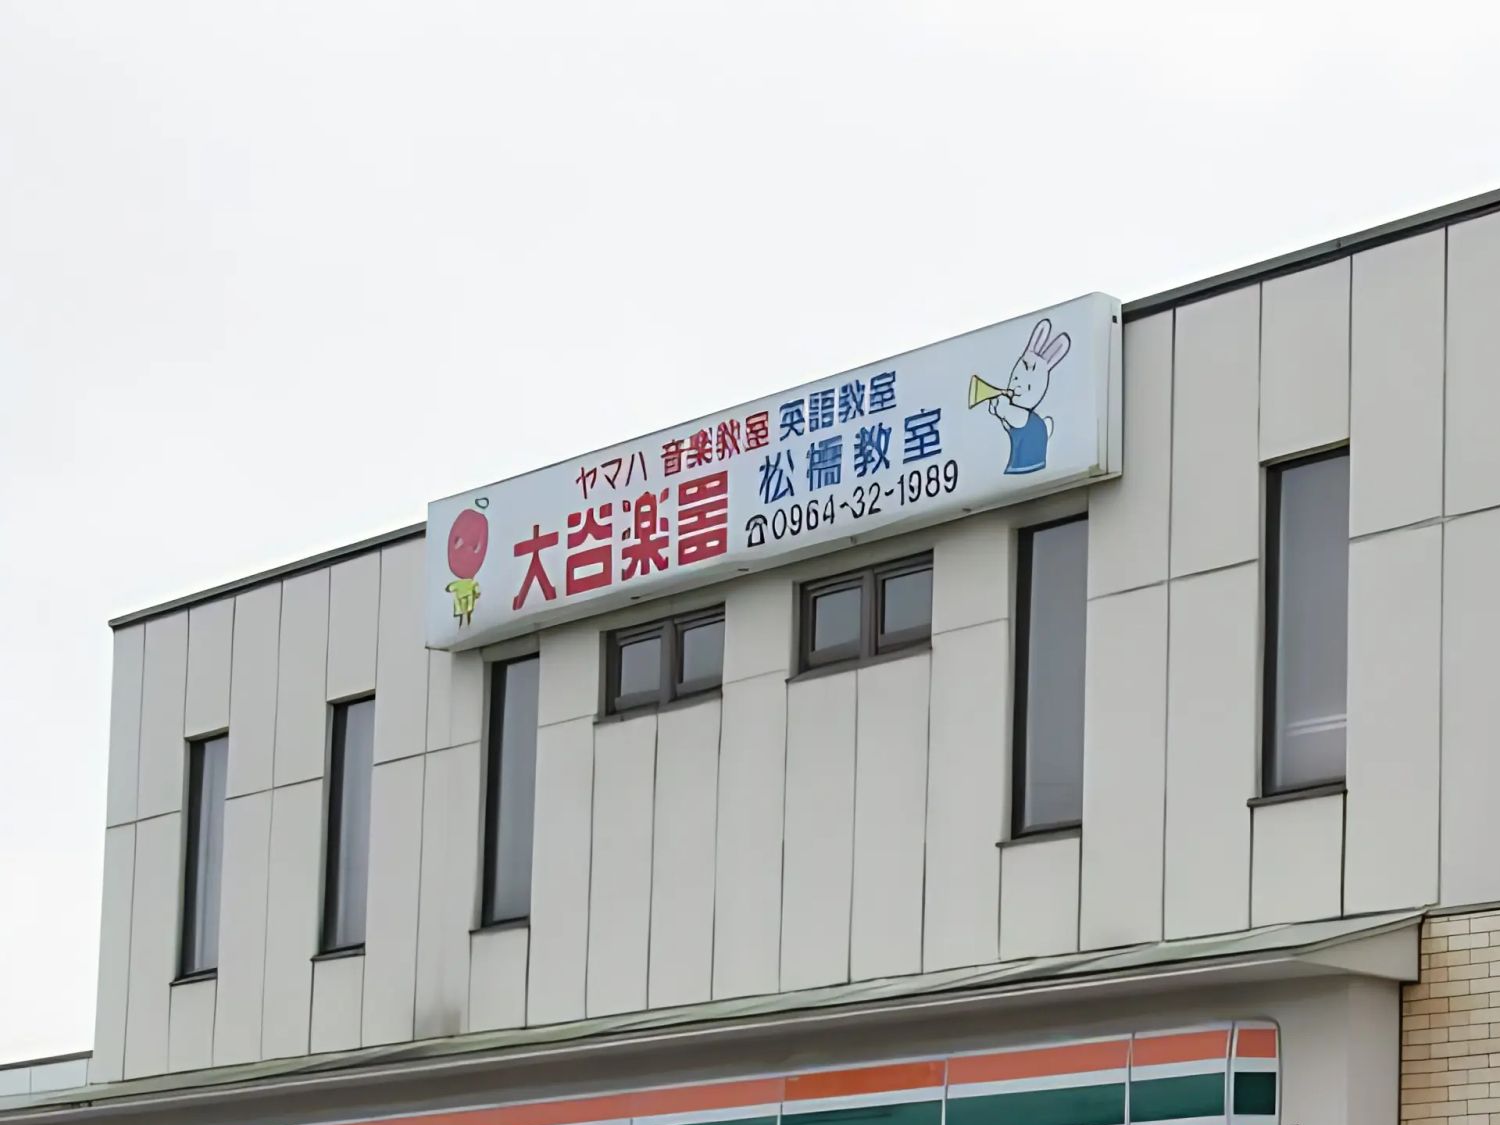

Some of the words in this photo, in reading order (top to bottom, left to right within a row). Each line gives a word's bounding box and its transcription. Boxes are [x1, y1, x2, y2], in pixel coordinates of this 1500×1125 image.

[575, 450, 648, 500] ヤマハ
[779, 370, 897, 442] 英語教室
[759, 408, 943, 505] 松橋教室
[512, 470, 729, 611] 大谷楽器
